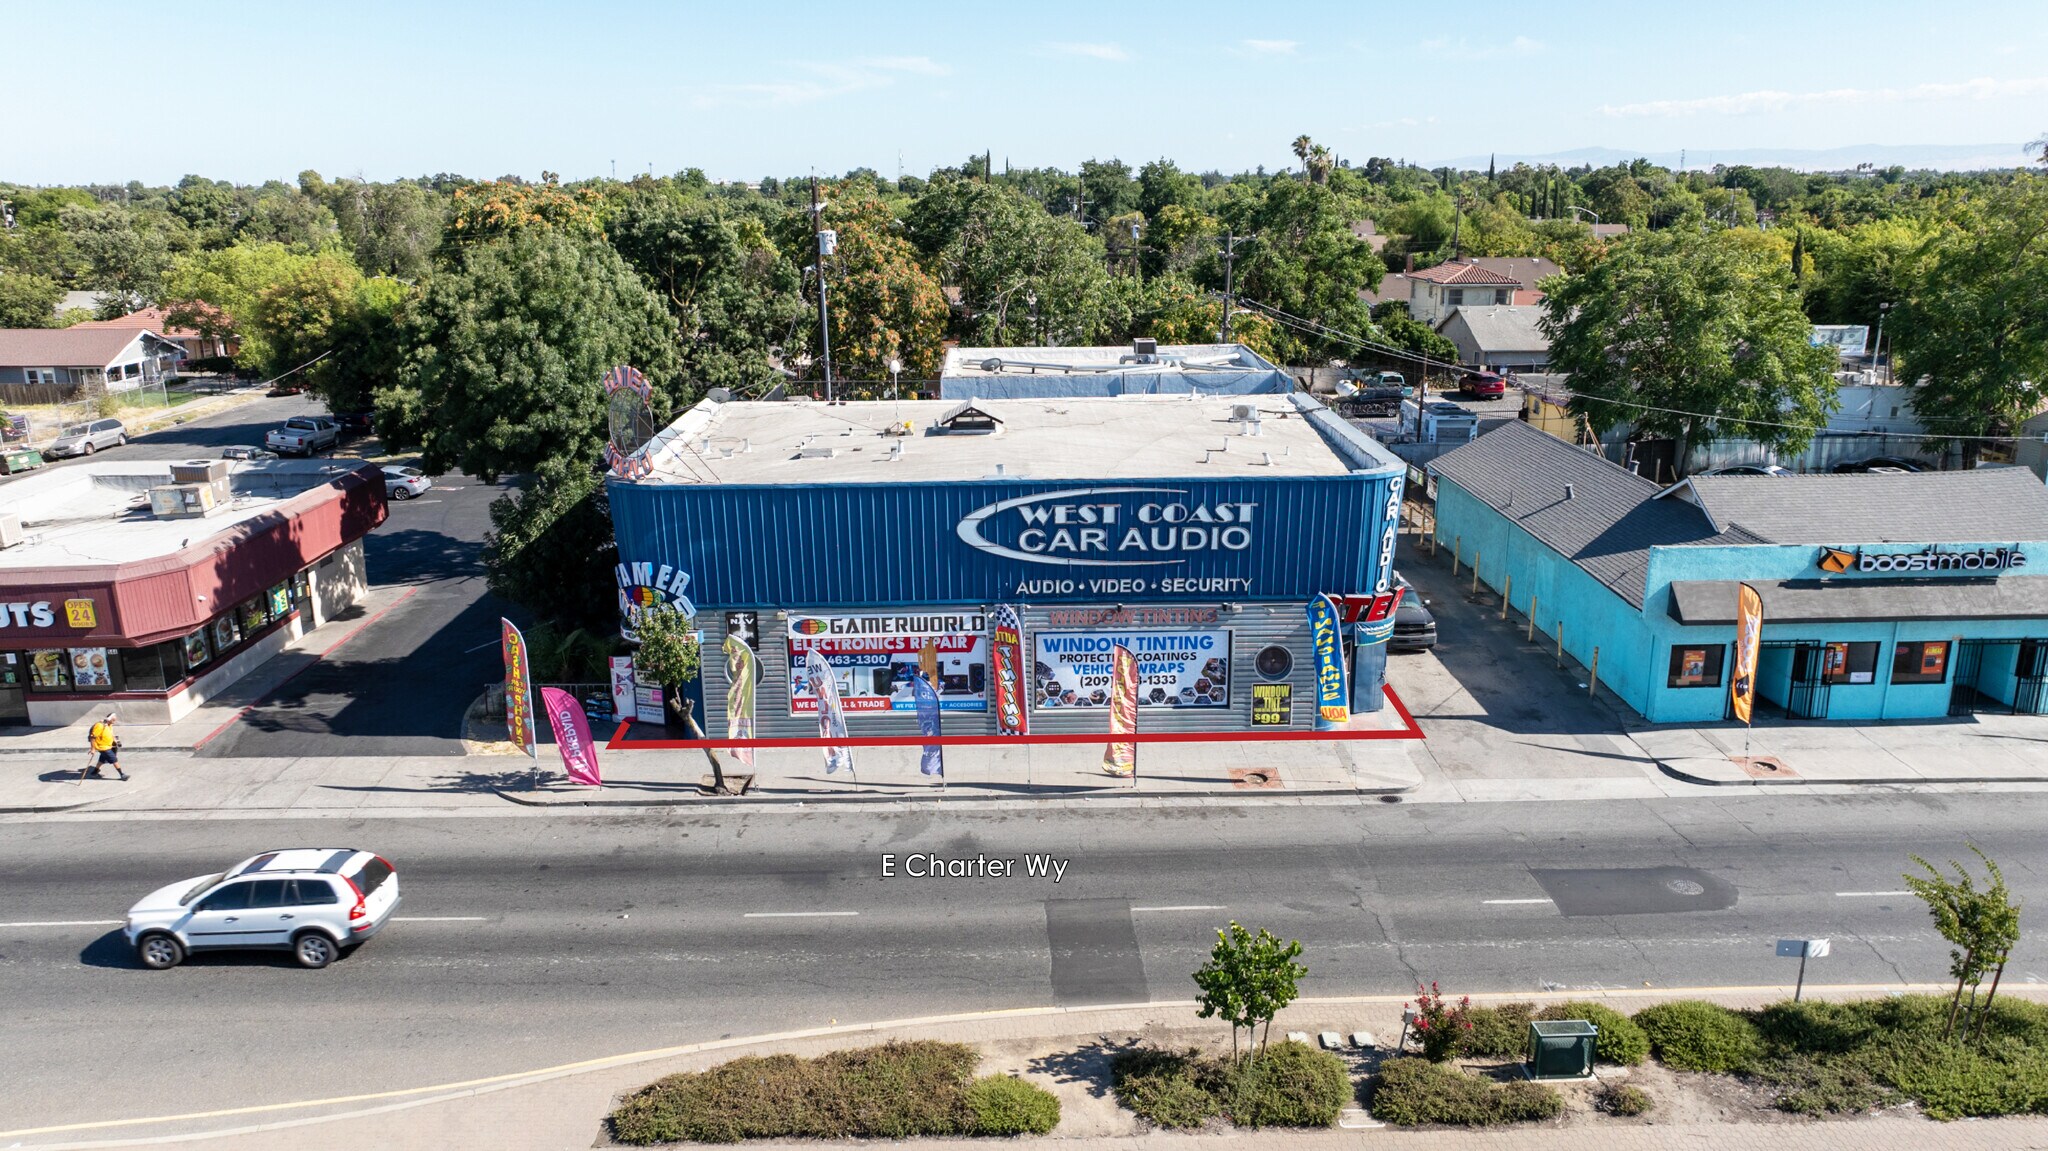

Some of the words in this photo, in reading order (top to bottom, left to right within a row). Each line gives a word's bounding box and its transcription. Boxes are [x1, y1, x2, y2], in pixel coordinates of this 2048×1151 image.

[1386, 477, 1401, 520] CAR
[1017, 504, 1122, 526] WEST
[1138, 502, 1259, 524] COAST
[1018, 528, 1109, 552] CAR
[1118, 526, 1251, 551] AUDIO
[1376, 526, 1394, 592] AUDIO
[1016, 579, 1074, 595] AUDIO
[1089, 578, 1146, 594] VIDEO
[1161, 577, 1252, 593] SECURITY
[66, 601, 91, 609] OPEN
[71, 609, 91, 621] 24
[1050, 610, 1136, 625] WINDOW
[1139, 608, 1218, 624] TINTING
[830, 615, 985, 634] GAMERWORLD
[792, 636, 906, 651] ELECTRONICS
[909, 636, 968, 649] REPAIR
[1043, 637, 1130, 652] WINDOW
[1136, 635, 1214, 650] TINTING
[829, 655, 887, 665] 463-1300
[1060, 654, 1114, 663] PROTECTI
[1137, 652, 1197, 662] COATINGS
[1072, 663, 1114, 675] VEHIC
[1137, 662, 1185, 674] WRAPS
[1138, 675, 1177, 685] -1333
[1253, 685, 1290, 698] WINDOW
[796, 701, 809, 709] WE
[857, 700, 885, 708] TRADE
[1263, 697, 1281, 708] TINT
[1254, 713, 1281, 724] $99
